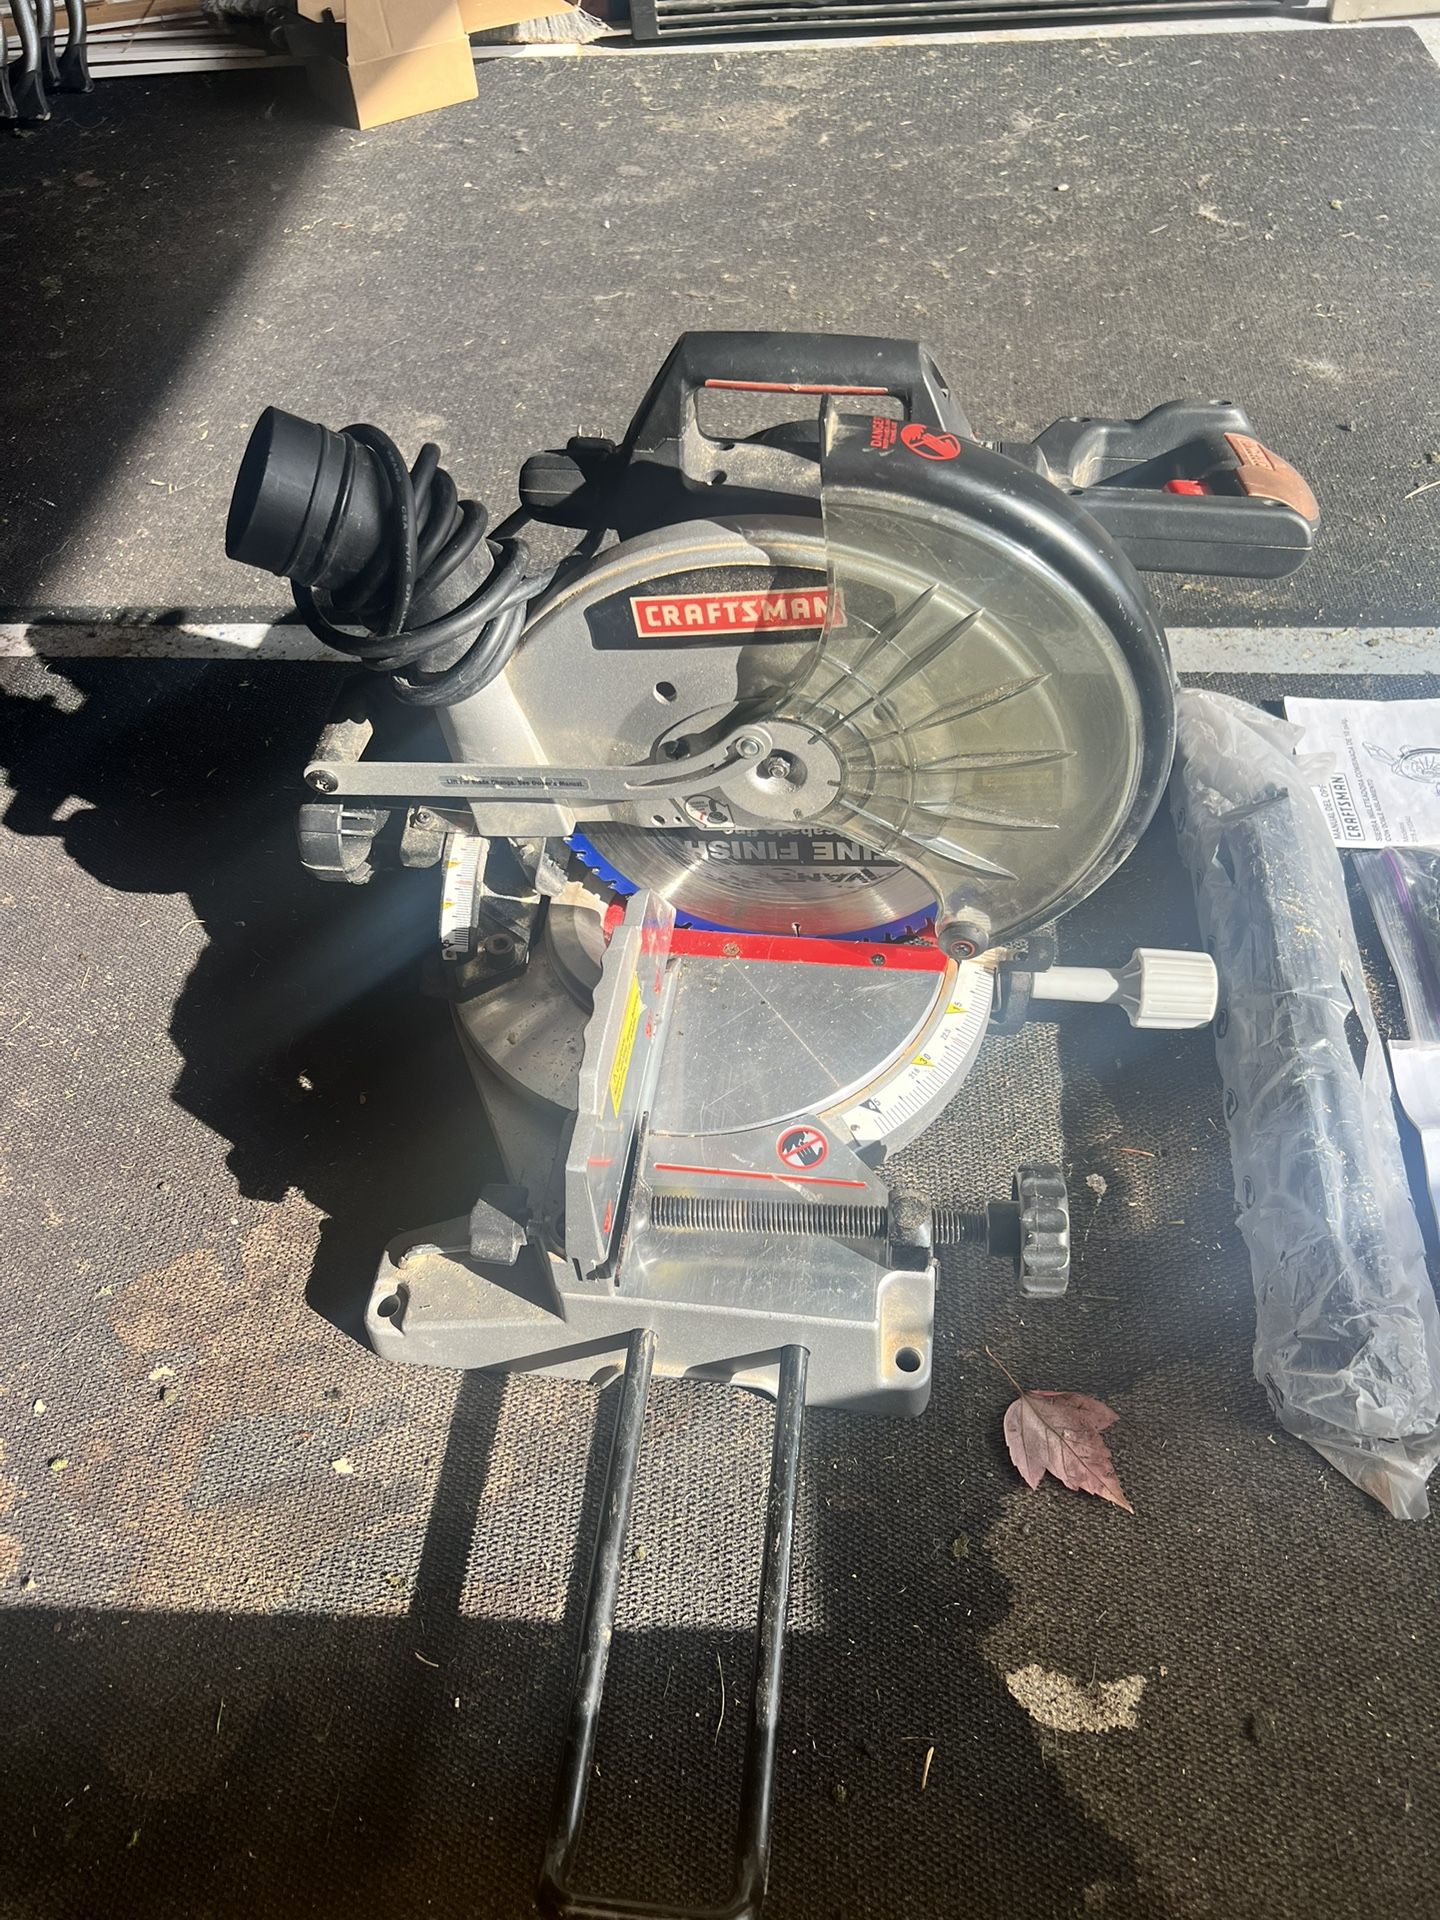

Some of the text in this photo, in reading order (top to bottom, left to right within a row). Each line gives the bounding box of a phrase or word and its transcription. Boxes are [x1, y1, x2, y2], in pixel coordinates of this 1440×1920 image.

[644, 596, 834, 628] CRAFTSMAN
[1331, 776, 1361, 838] CRAFTSMAN
[684, 840, 799, 861] FINISH
[919, 1053, 931, 1064] 30
[868, 1099, 881, 1110] 45
